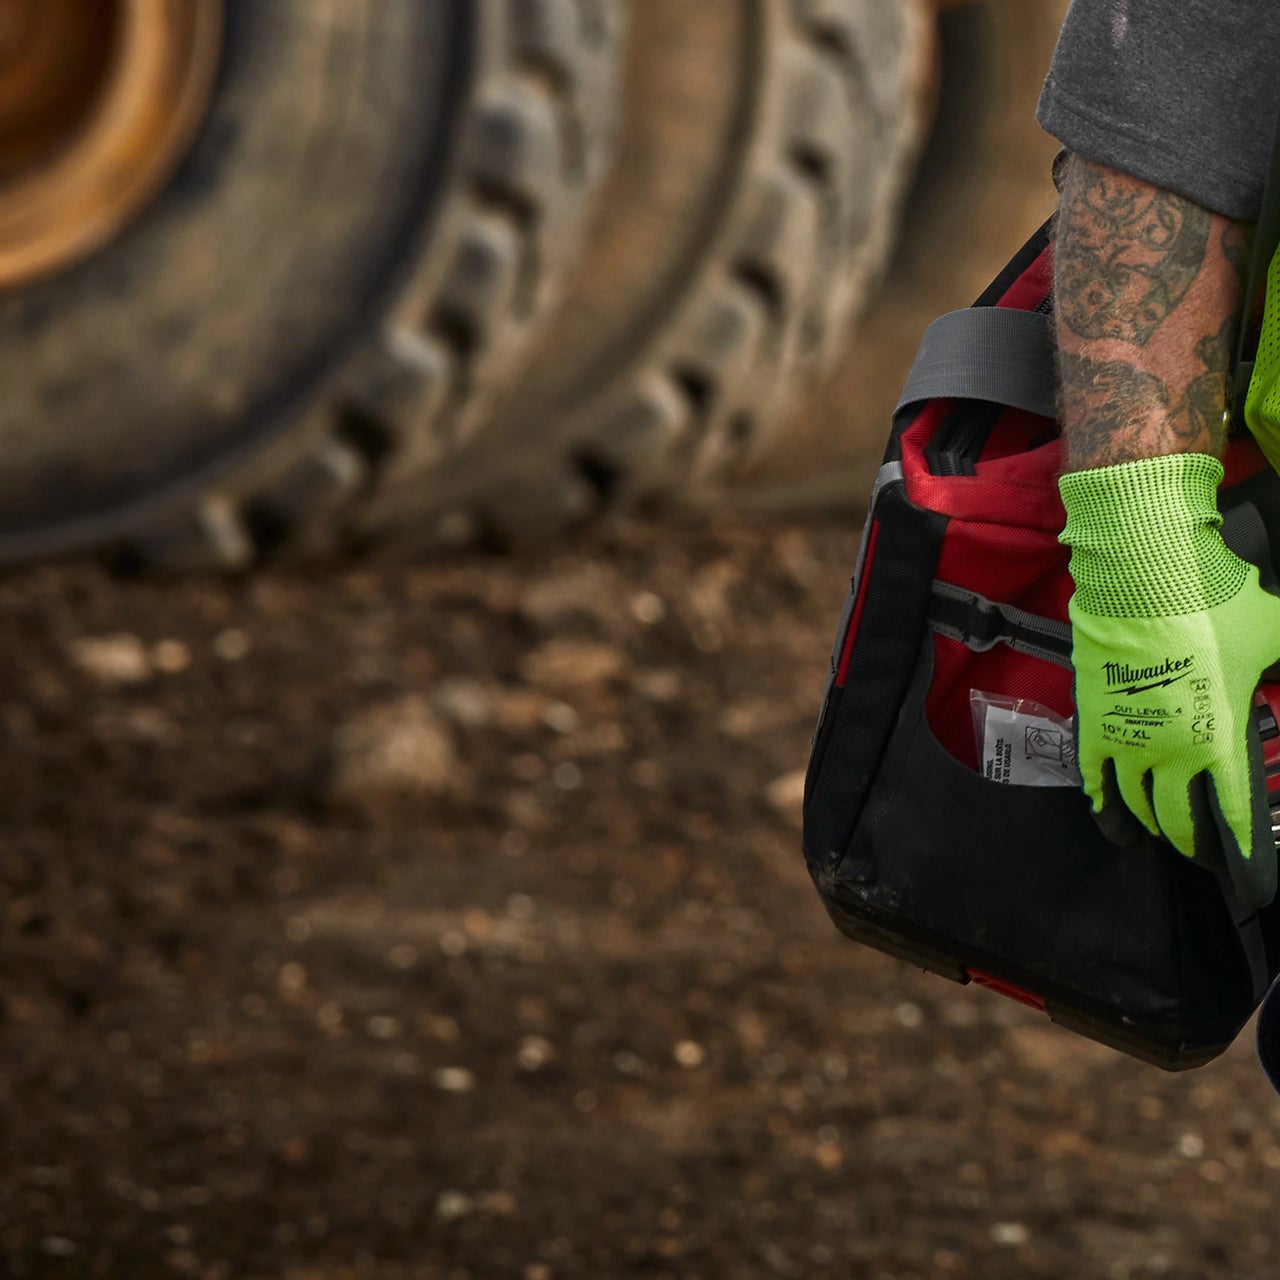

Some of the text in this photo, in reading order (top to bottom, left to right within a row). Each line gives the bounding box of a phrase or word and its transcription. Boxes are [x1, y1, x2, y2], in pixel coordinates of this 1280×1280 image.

[1101, 656, 1193, 686] Milwaukee
[1115, 705, 1132, 714] CUT
[1137, 707, 1169, 716] LEVEL
[1133, 729, 1151, 740] XL
